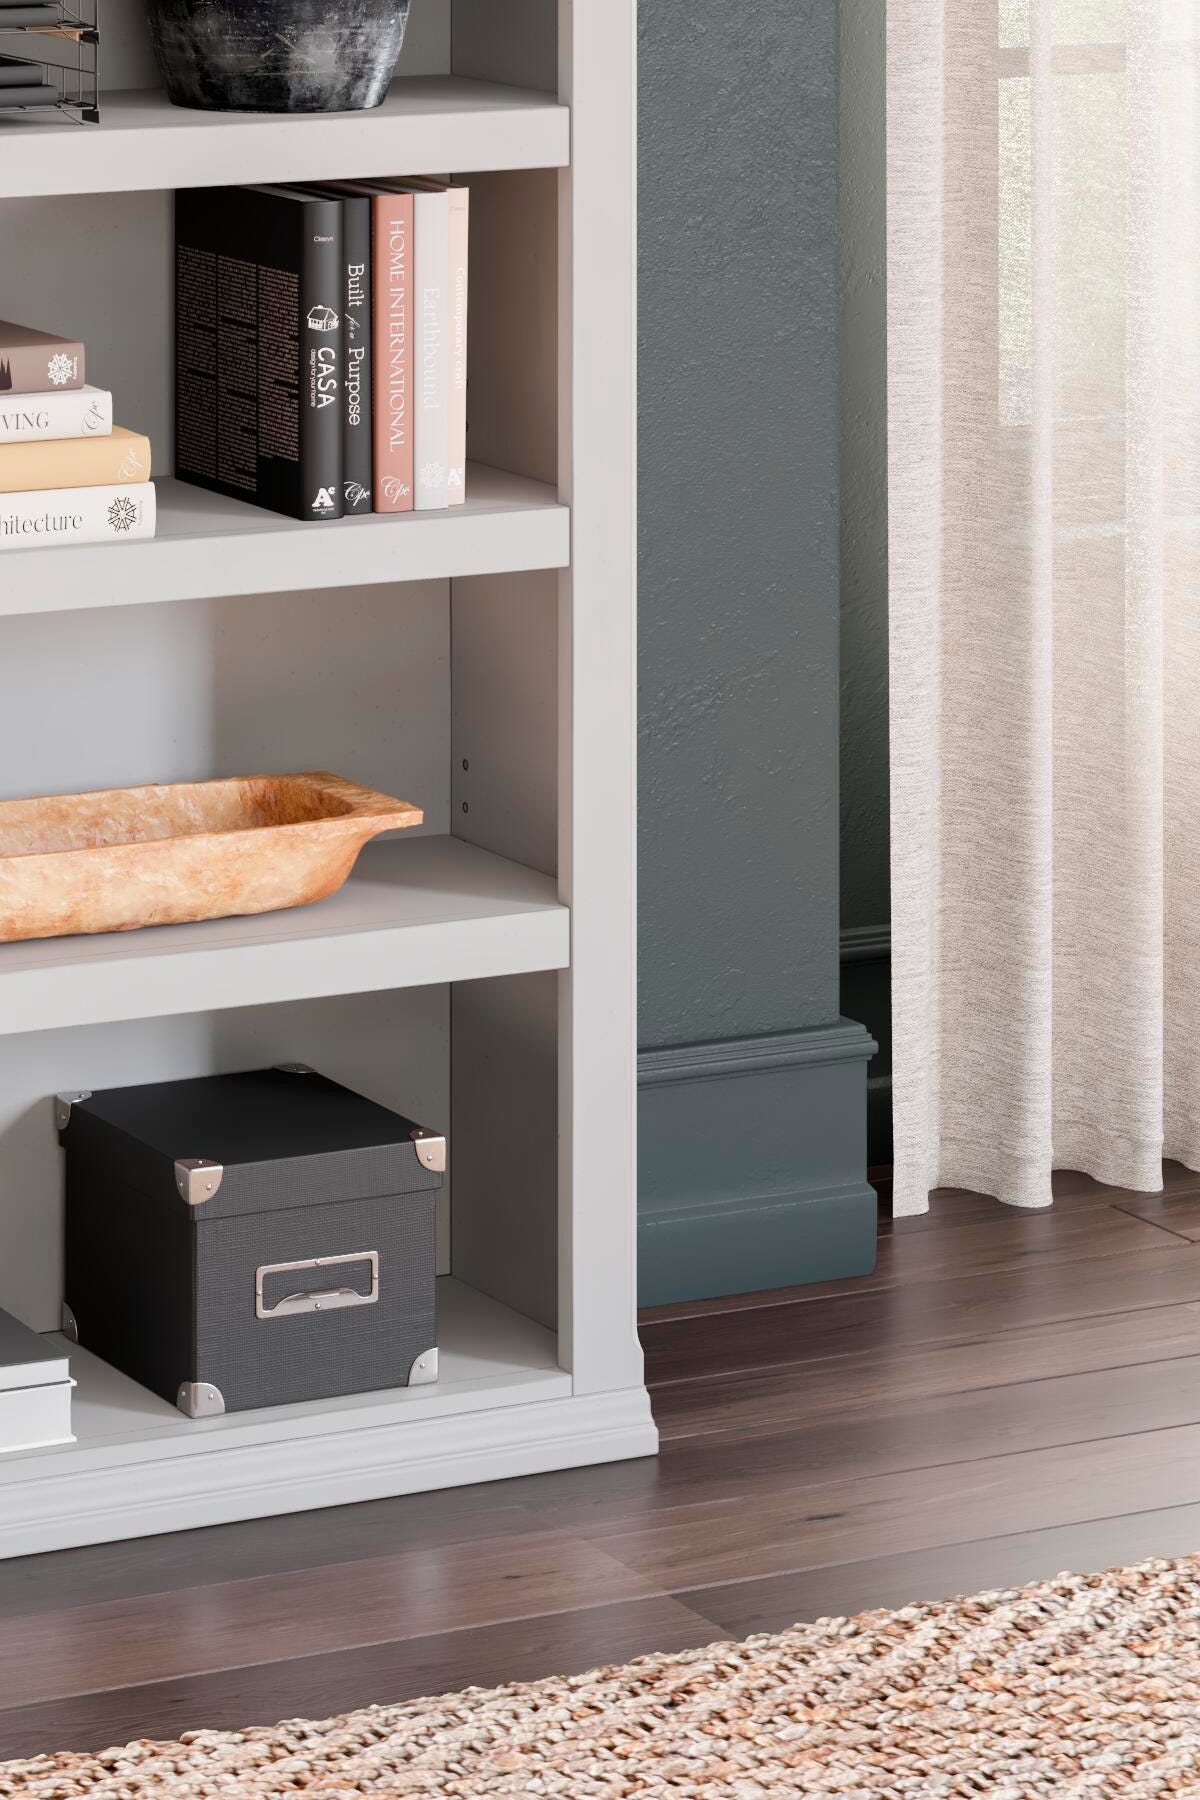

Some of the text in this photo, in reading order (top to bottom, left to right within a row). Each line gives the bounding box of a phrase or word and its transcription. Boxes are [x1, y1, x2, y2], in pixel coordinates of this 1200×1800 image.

[348, 264, 365, 308] Built
[454, 266, 465, 358] Contemporary
[309, 348, 317, 367] design
[389, 220, 405, 453] HOME INTERNATIONAL
[423, 287, 441, 409] Earthbound
[316, 346, 338, 409] CASA
[345, 346, 365, 426] Purpose
